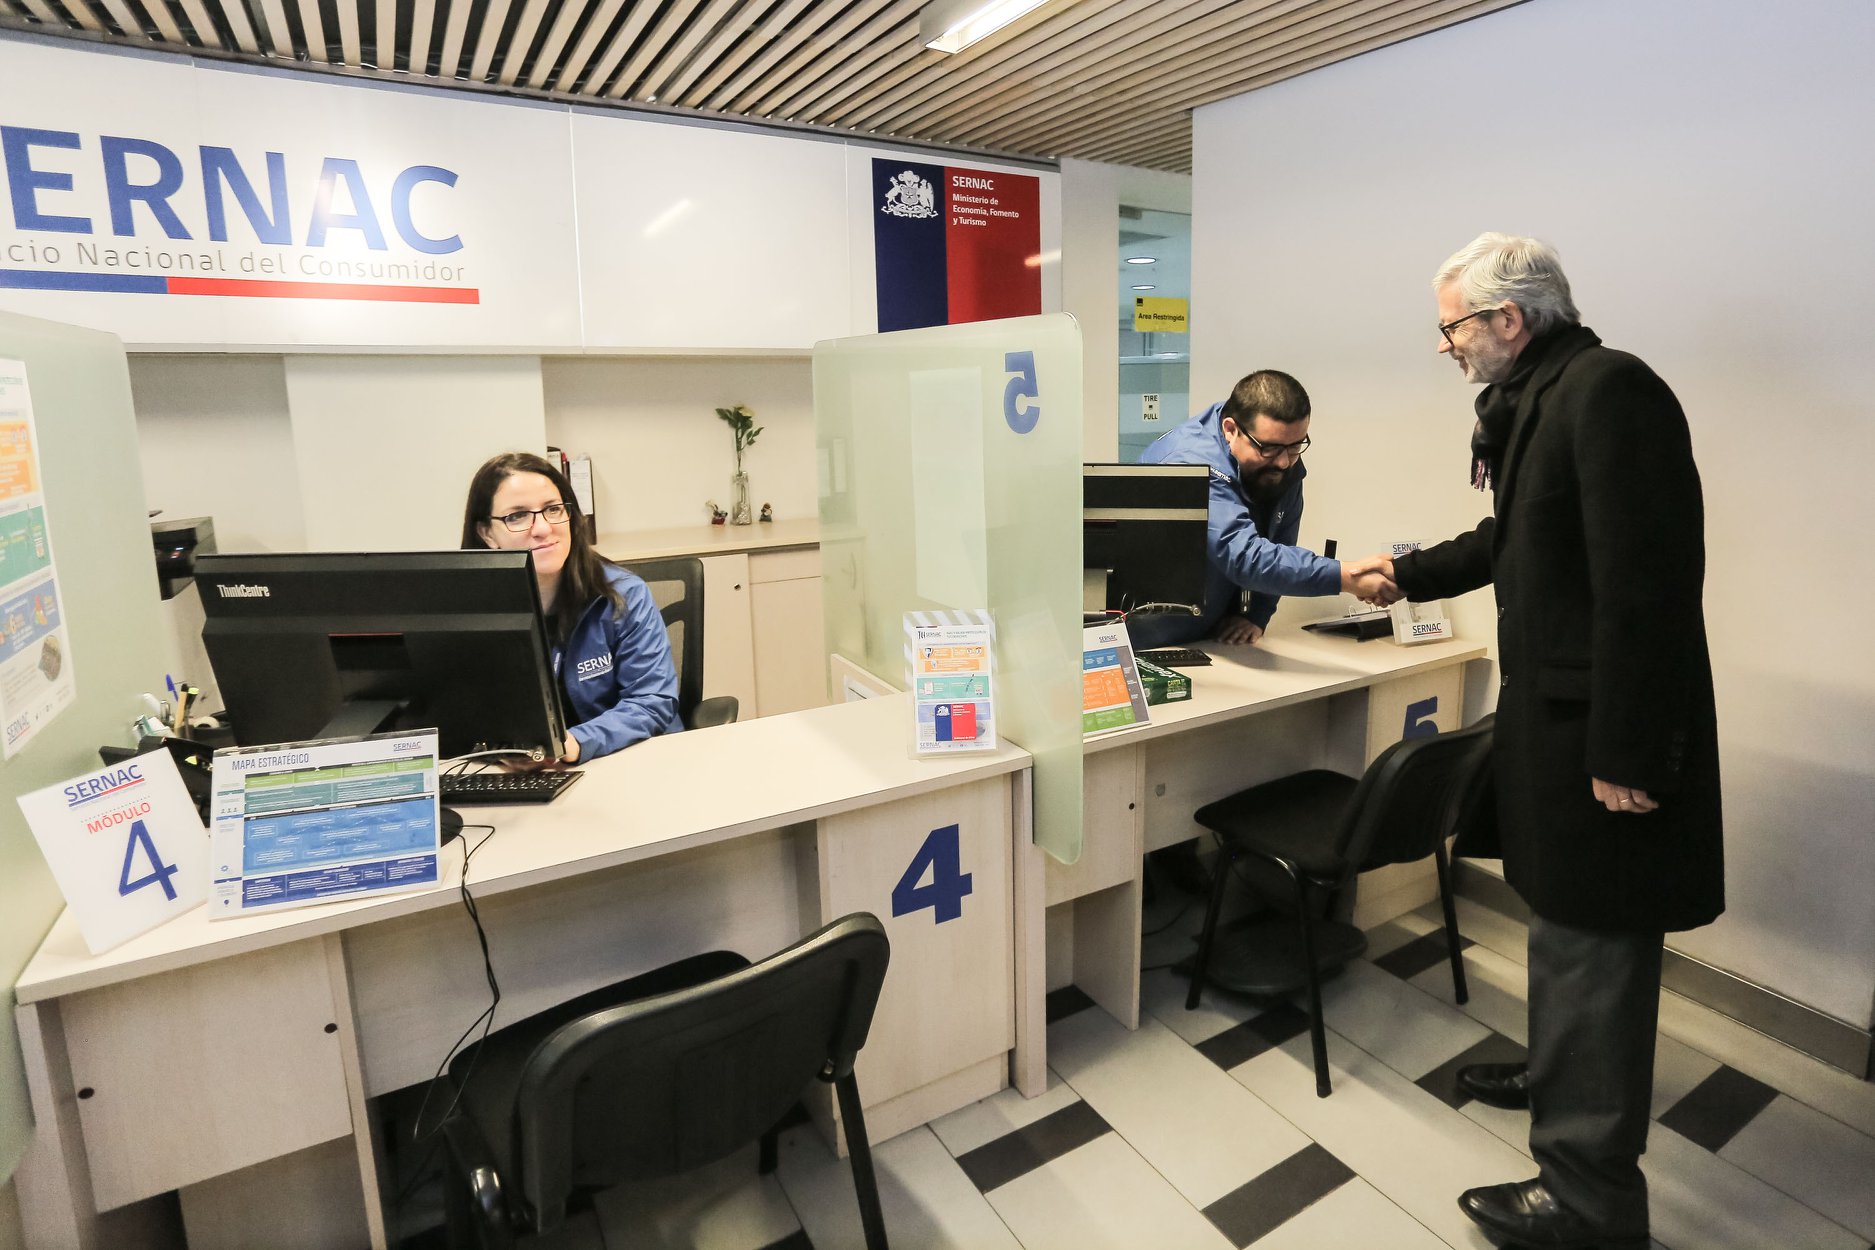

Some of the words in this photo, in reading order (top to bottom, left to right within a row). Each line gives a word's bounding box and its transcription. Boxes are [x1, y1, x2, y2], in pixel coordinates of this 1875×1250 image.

[953, 176, 994, 190] SERNAC
[952, 193, 988, 204] Ministerio
[989, 197, 999, 205] de
[990, 208, 1019, 218] Fomento
[952, 217, 958, 226] y
[959, 217, 987, 227] Turismo
[77, 242, 226, 272] Nacional
[240, 251, 287, 275] del
[299, 254, 465, 282] Consumidor
[1153, 313, 1185, 323] Restringida
[1392, 542, 1422, 553] SERNAC
[216, 584, 270, 598] ThinkCentre
[1412, 622, 1442, 634] SERNAC
[1402, 695, 1439, 743] 5
[231, 759, 256, 771] MAPA
[258, 752, 310, 768] ESTRATÉGICO
[63, 764, 143, 804] SERNAC
[118, 819, 179, 902] 4
[891, 823, 973, 925] 4
